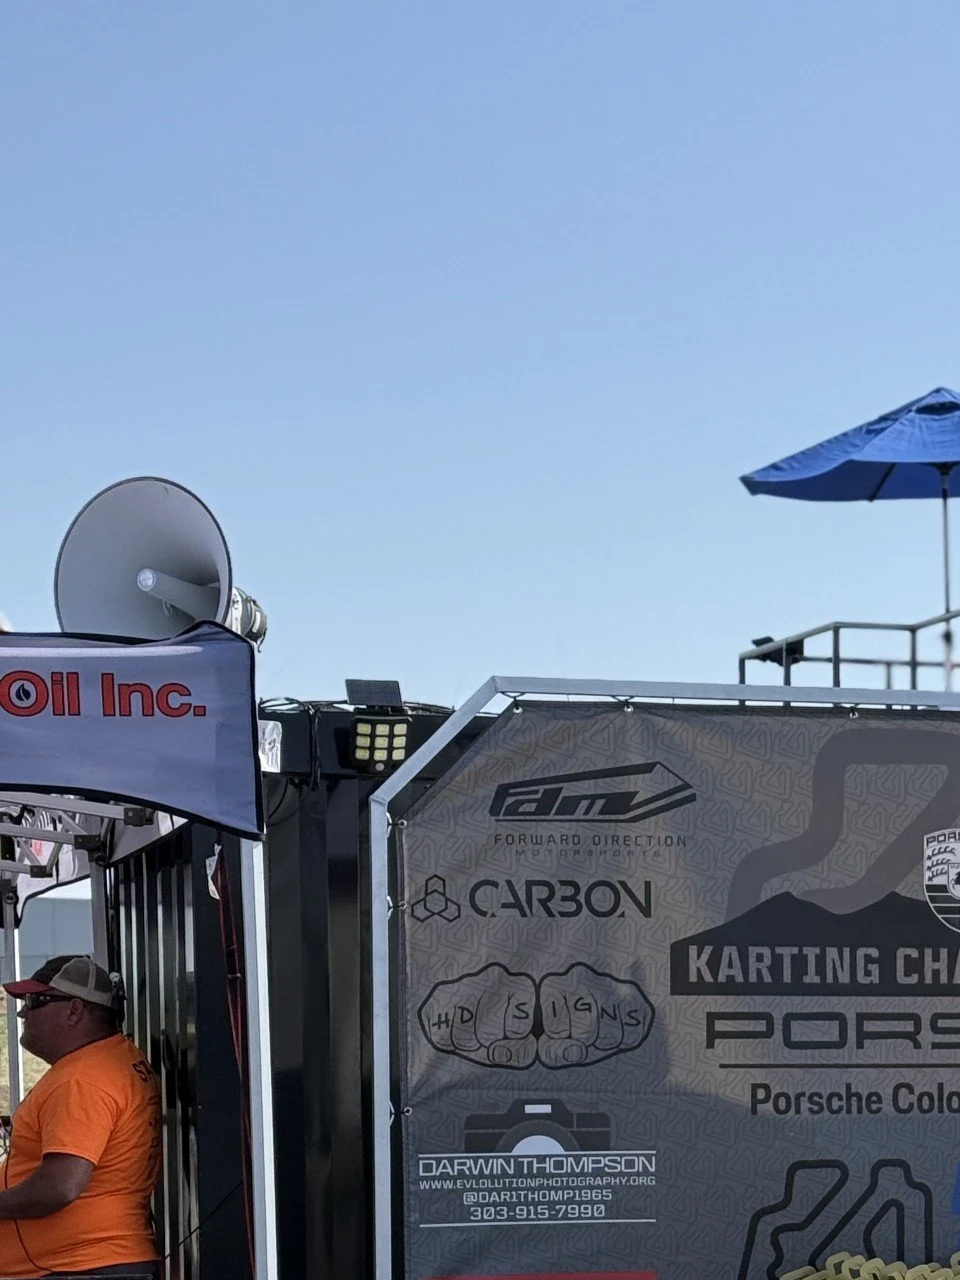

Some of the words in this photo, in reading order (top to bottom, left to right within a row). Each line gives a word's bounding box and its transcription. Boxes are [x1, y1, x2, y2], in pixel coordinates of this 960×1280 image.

[0, 670, 81, 717] Oil
[101, 672, 206, 717] Inc.
[494, 833, 581, 846] FORWARD
[593, 834, 688, 847] DIRECTION
[469, 879, 652, 918] CARBON
[687, 945, 880, 984] KARTING
[750, 1082, 883, 1115] Porsche
[419, 1158, 515, 1176] DARWIN
[518, 1156, 656, 1175] THOMPSON
[419, 1176, 656, 1189] WWW.EVLOLUTIONPHOTOGRAPHY.ORG
[463, 1189, 612, 1204] @DAR1THOMP1965
[470, 1204, 605, 1220] 303-915-7990
